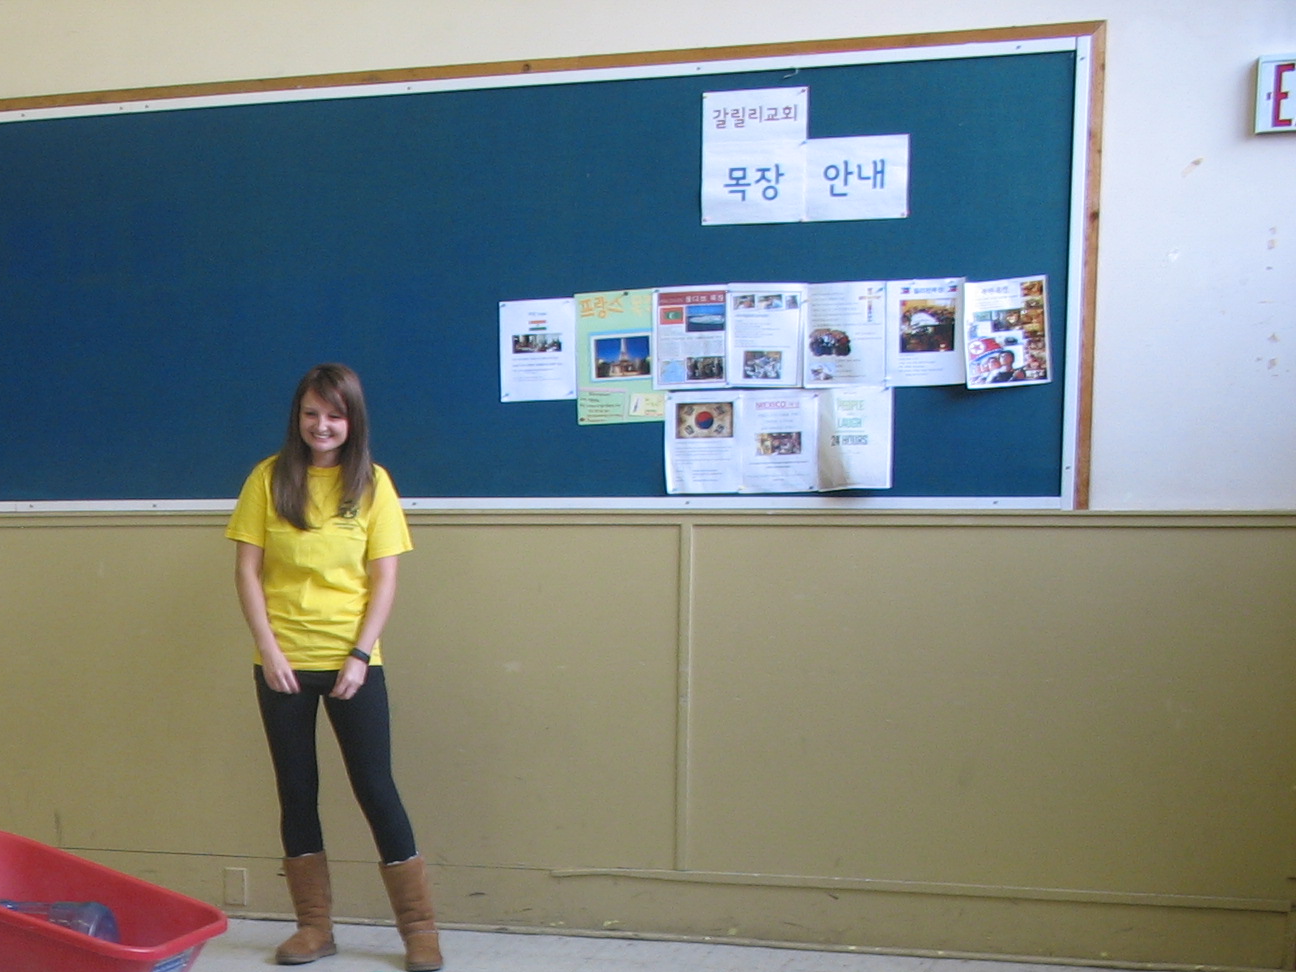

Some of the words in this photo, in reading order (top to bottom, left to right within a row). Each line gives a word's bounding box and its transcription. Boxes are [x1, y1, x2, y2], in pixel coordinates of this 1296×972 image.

[1271, 63, 1296, 127] E
[712, 104, 798, 129] 갈릴리교회
[723, 163, 785, 202] 목장
[823, 158, 886, 198] 안내
[579, 295, 625, 319] 프랑스
